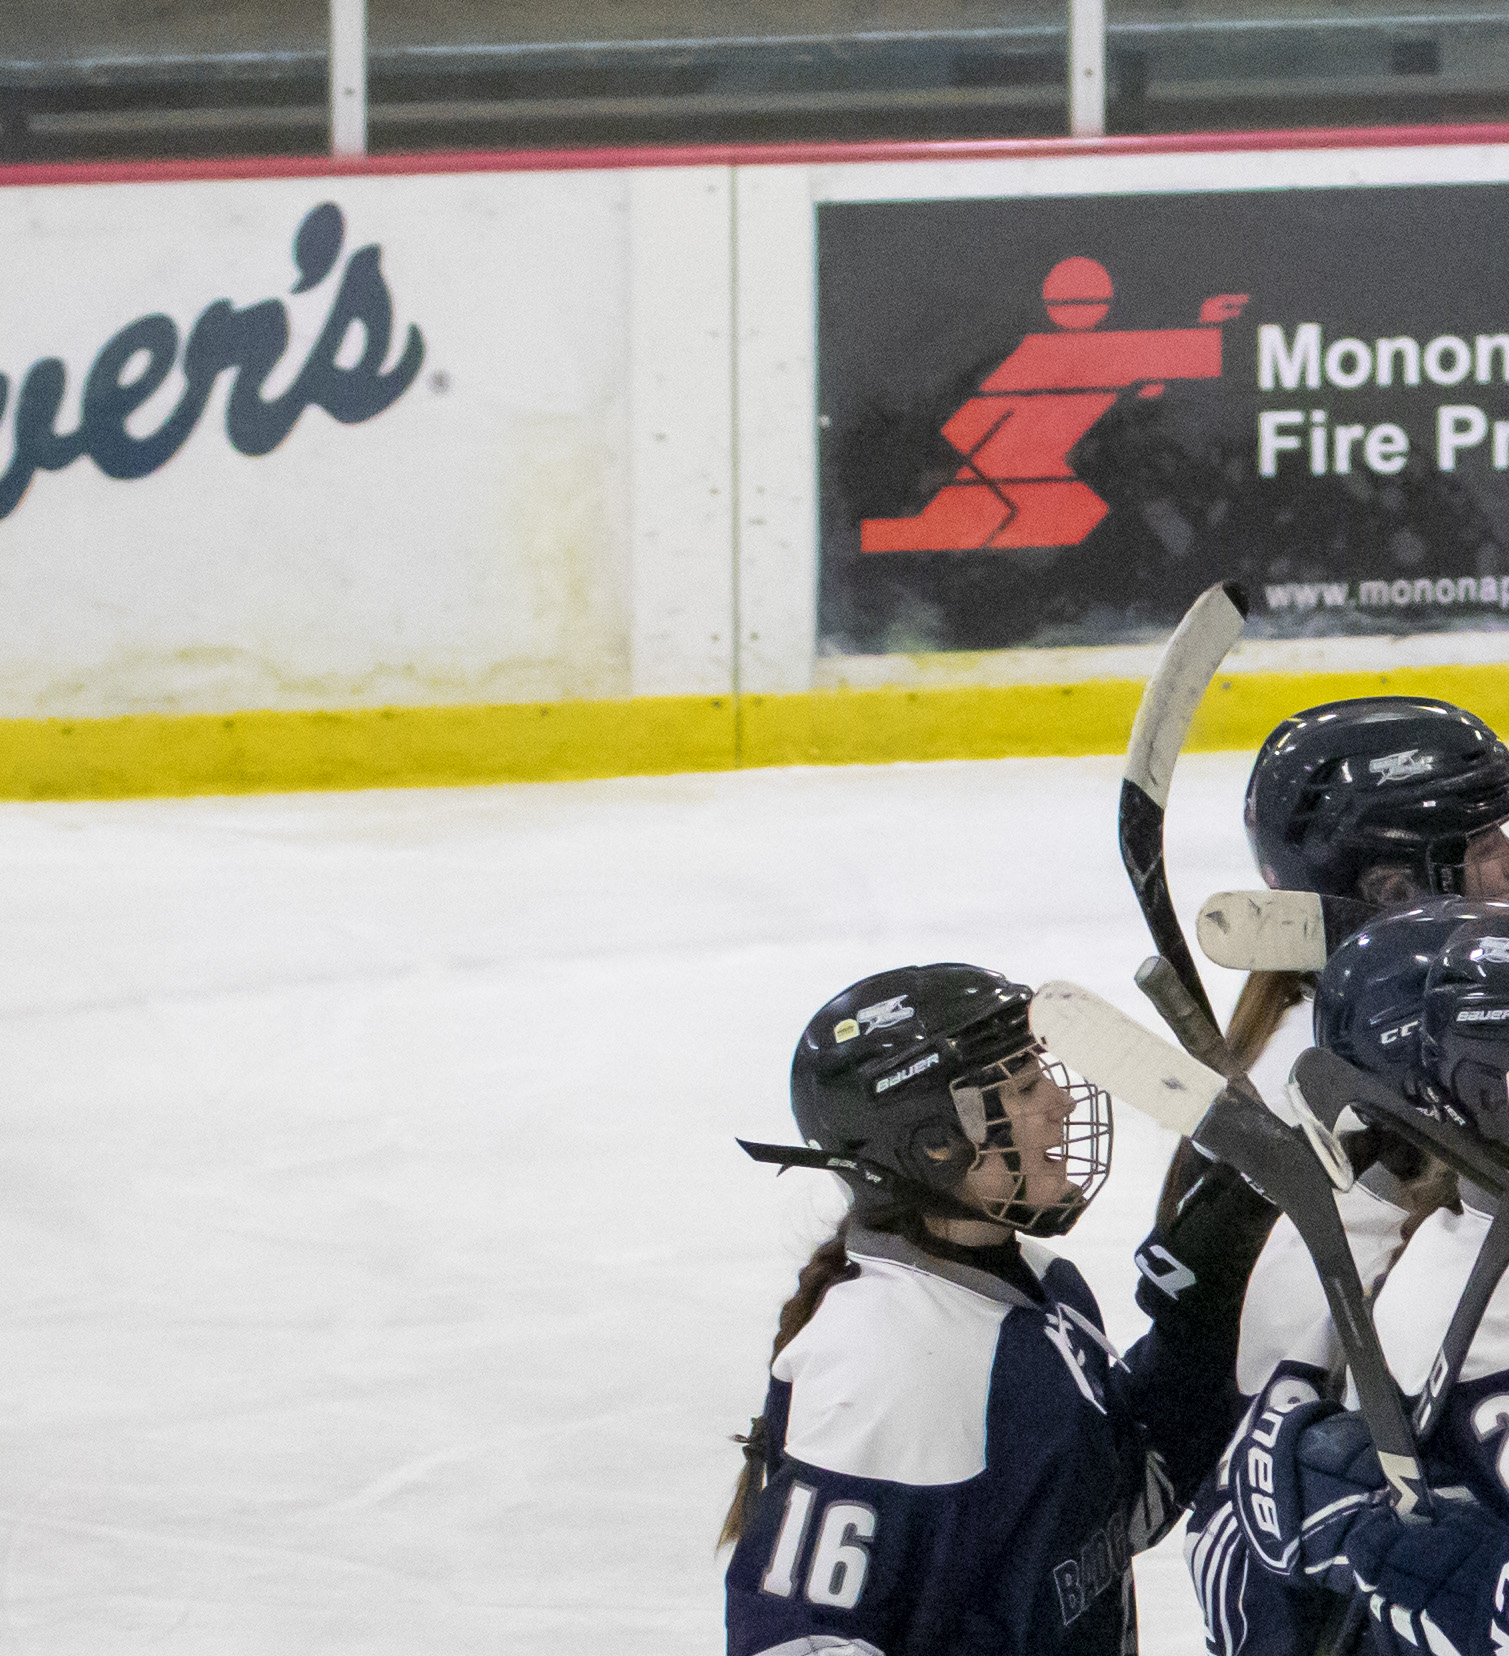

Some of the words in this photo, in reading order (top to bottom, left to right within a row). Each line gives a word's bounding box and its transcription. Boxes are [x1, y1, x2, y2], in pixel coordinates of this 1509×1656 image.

[1258, 408, 1410, 477] Fire
[1380, 1021, 1420, 1044] CC
[761, 1484, 876, 1610] 16
